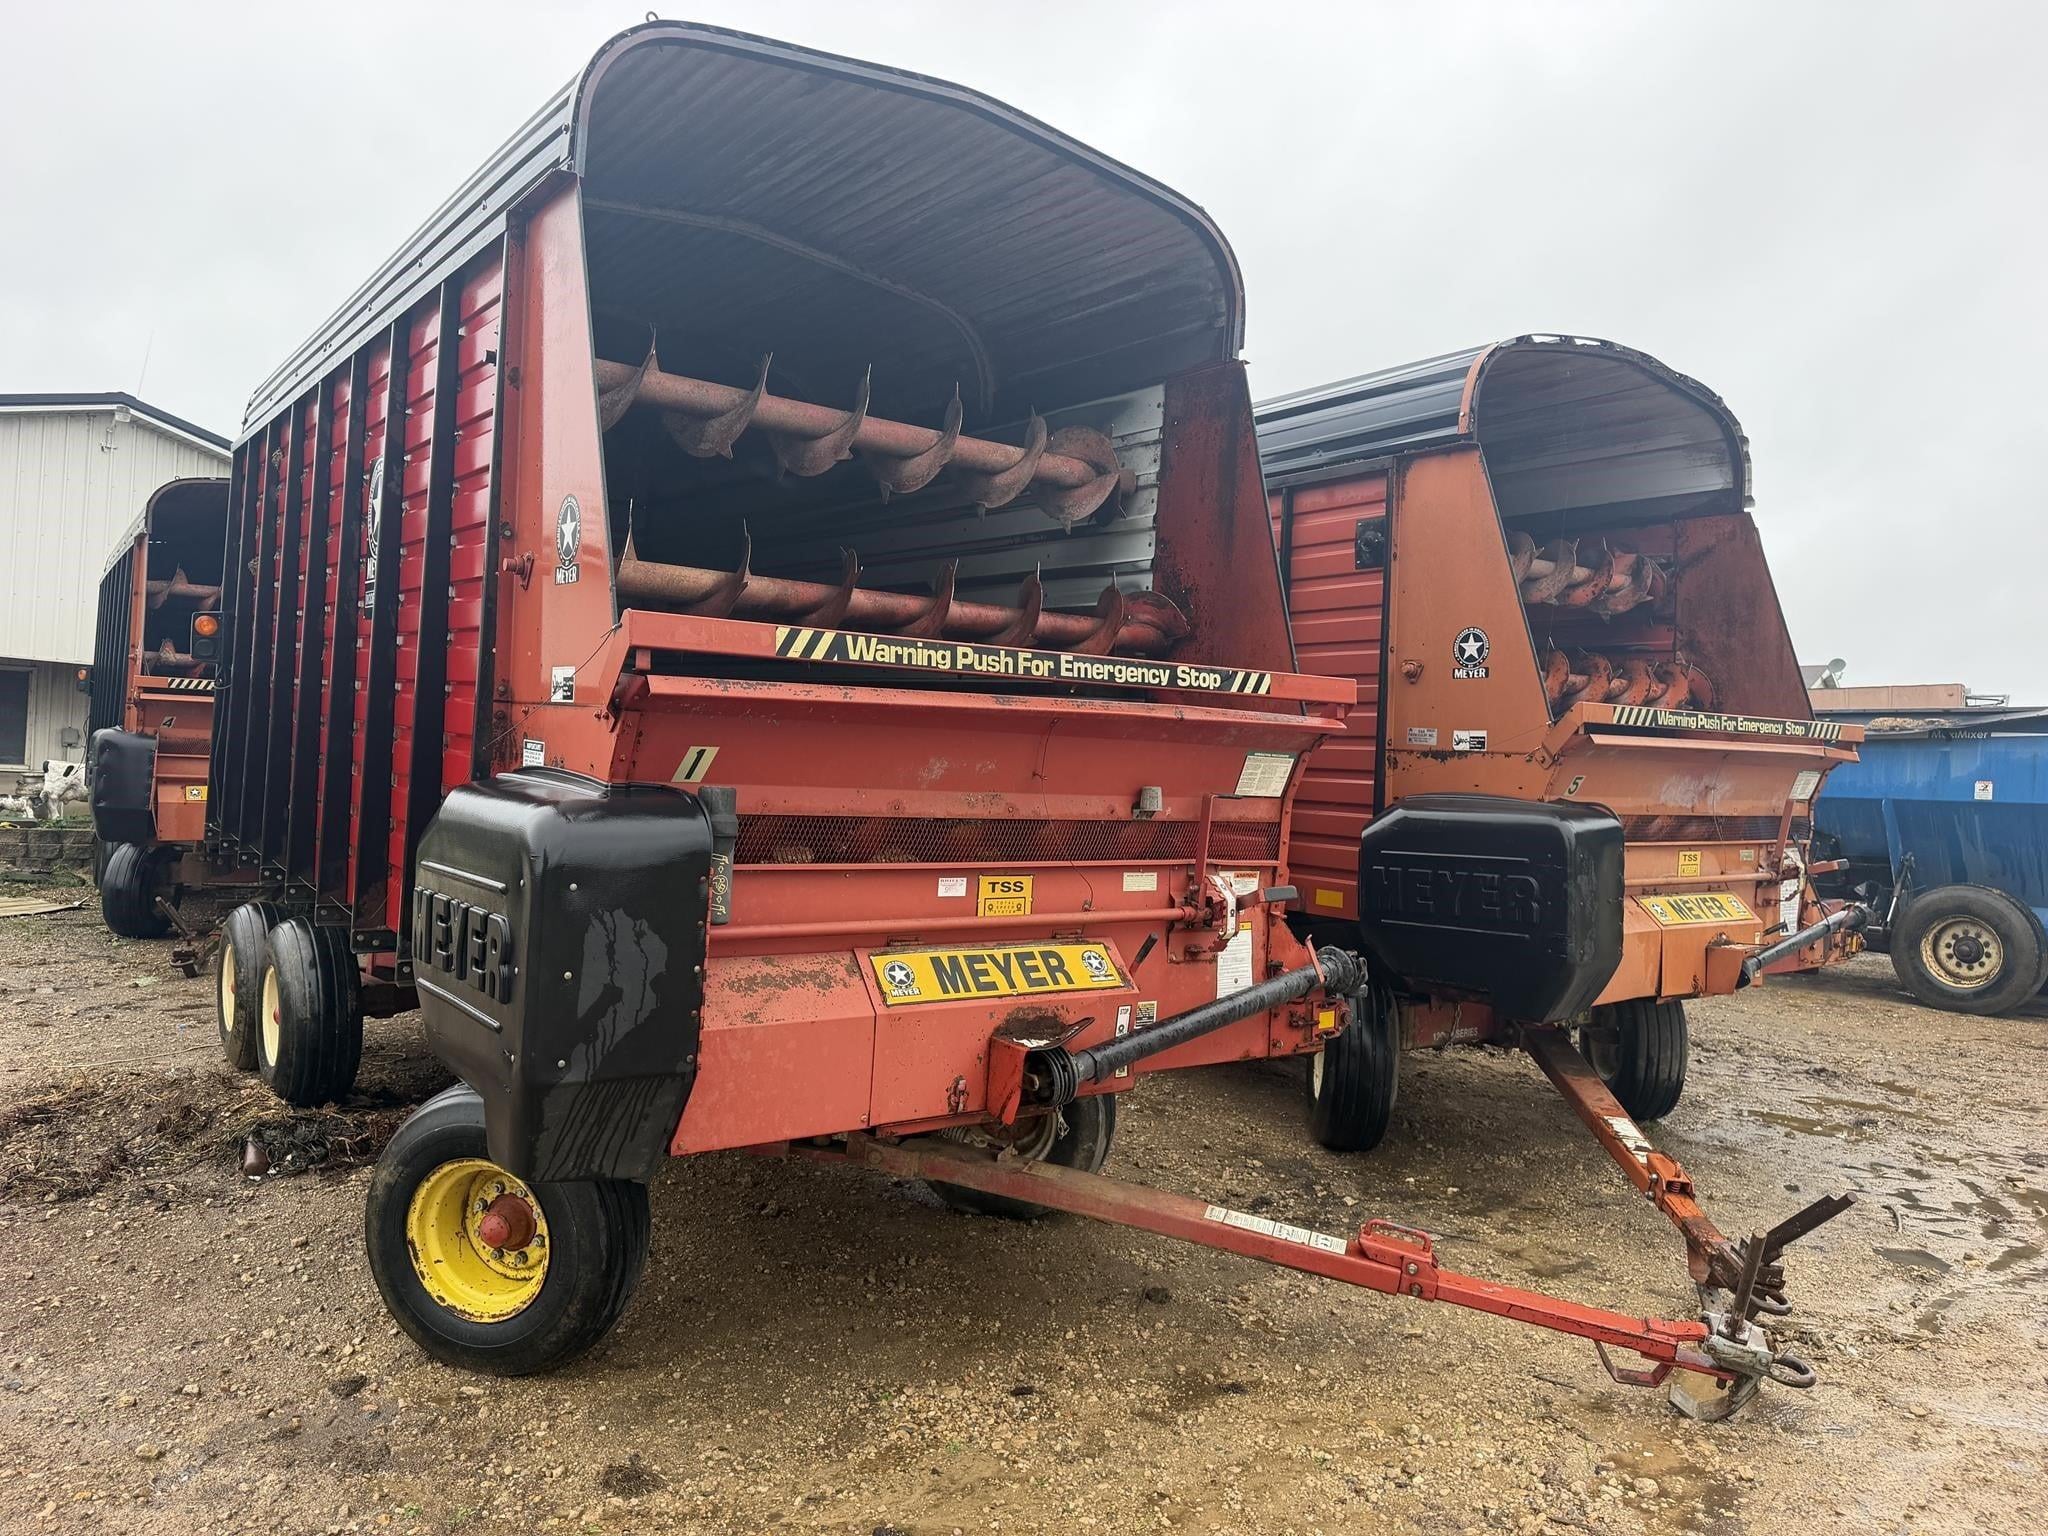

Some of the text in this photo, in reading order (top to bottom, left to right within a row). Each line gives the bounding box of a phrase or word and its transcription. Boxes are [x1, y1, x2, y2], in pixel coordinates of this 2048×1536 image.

[555, 565, 577, 585] MEYER
[846, 634, 1221, 689] Warning Push For Emergency Stop
[1454, 668, 1486, 679] MEYER
[162, 717, 174, 728] 4
[1657, 710, 1805, 736] Warning Push For Emergency Stop
[684, 749, 707, 780] 1
[1568, 776, 1584, 795] 5
[1682, 854, 1698, 862] TSS
[988, 881, 1025, 893] TSS
[1371, 865, 1541, 925] MEYER
[1666, 897, 1733, 921] MEYER
[412, 885, 511, 1005] MEYER
[929, 950, 1075, 995] MEYER
[891, 987, 921, 997] MEYER
[1455, 1027, 1478, 1038] SERIES
